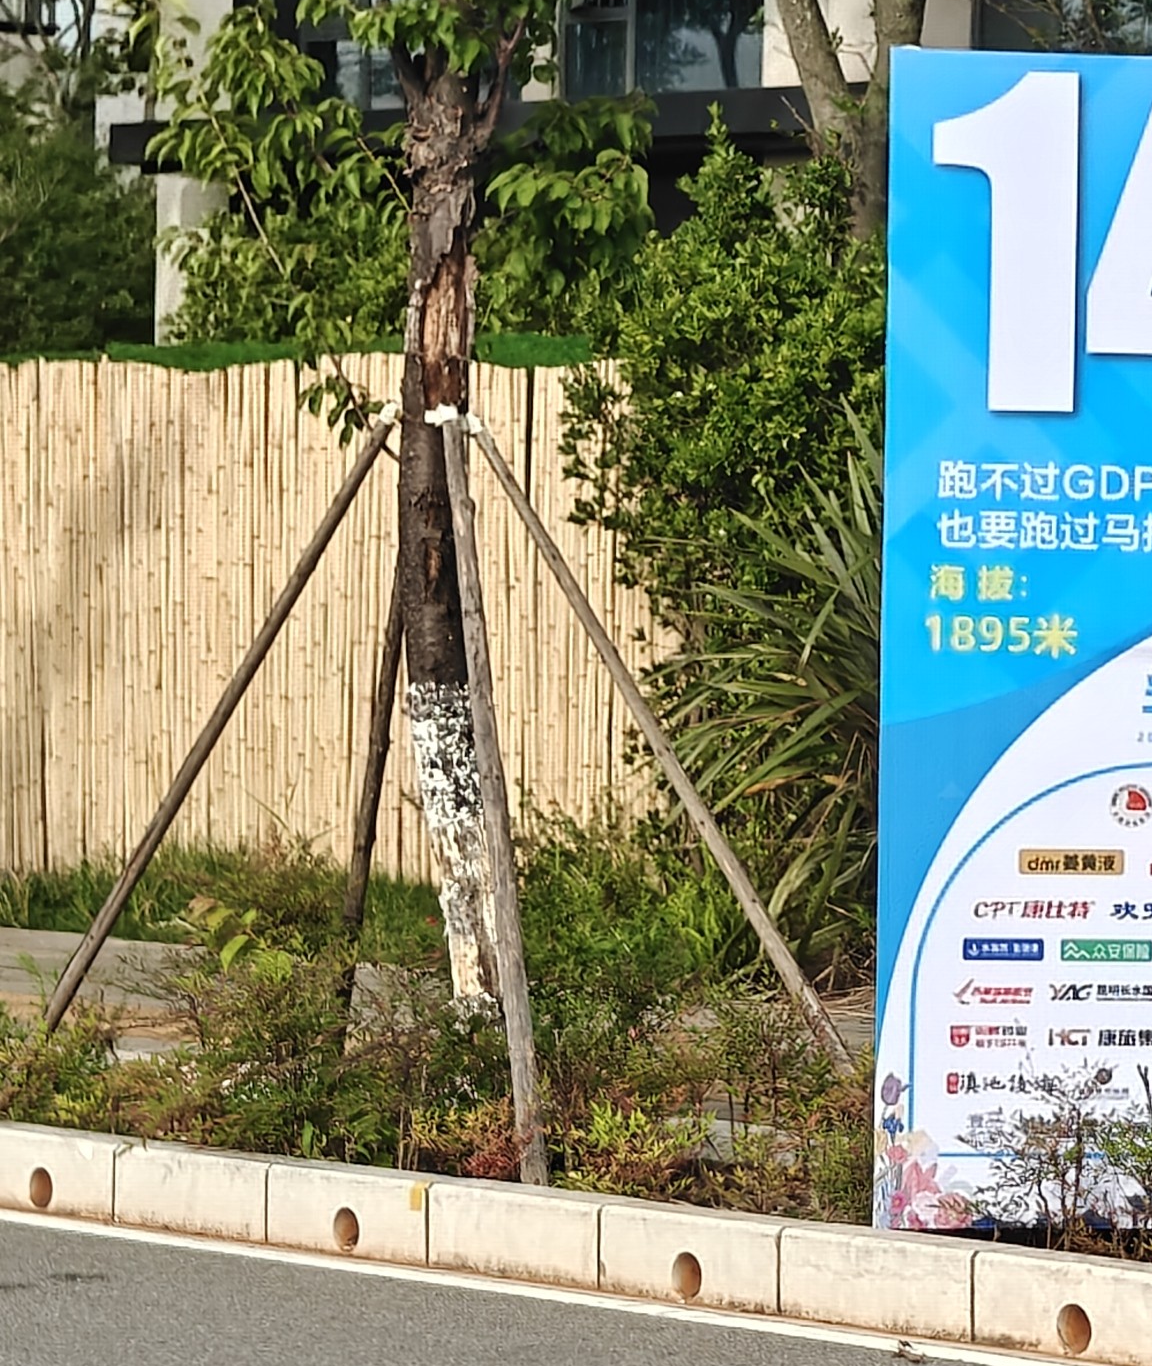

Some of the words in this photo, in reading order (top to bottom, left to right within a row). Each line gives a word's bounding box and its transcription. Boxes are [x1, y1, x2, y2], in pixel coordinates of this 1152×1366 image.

[925, 613, 1078, 659] 1895米
[1092, 943, 1150, 960] 众安保险
